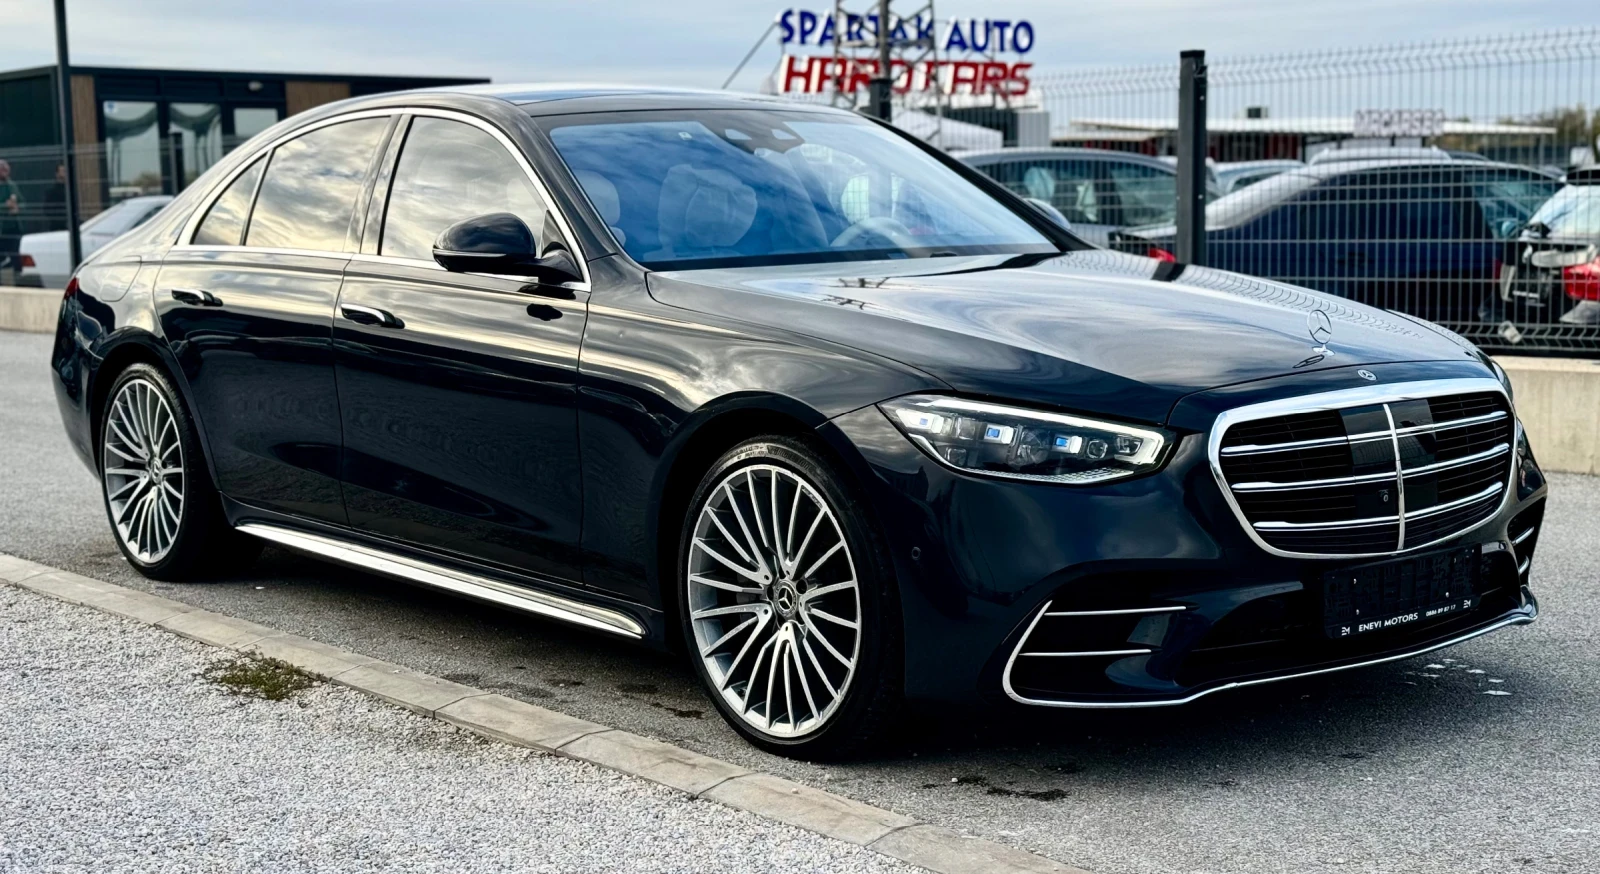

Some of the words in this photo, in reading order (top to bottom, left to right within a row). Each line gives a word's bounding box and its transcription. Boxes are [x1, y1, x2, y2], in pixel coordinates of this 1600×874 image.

[778, 8, 934, 50] SPARTAK
[945, 19, 1035, 53] AUTO
[1358, 620, 1382, 632] ENEVI
[1384, 612, 1419, 627] MOTORS
